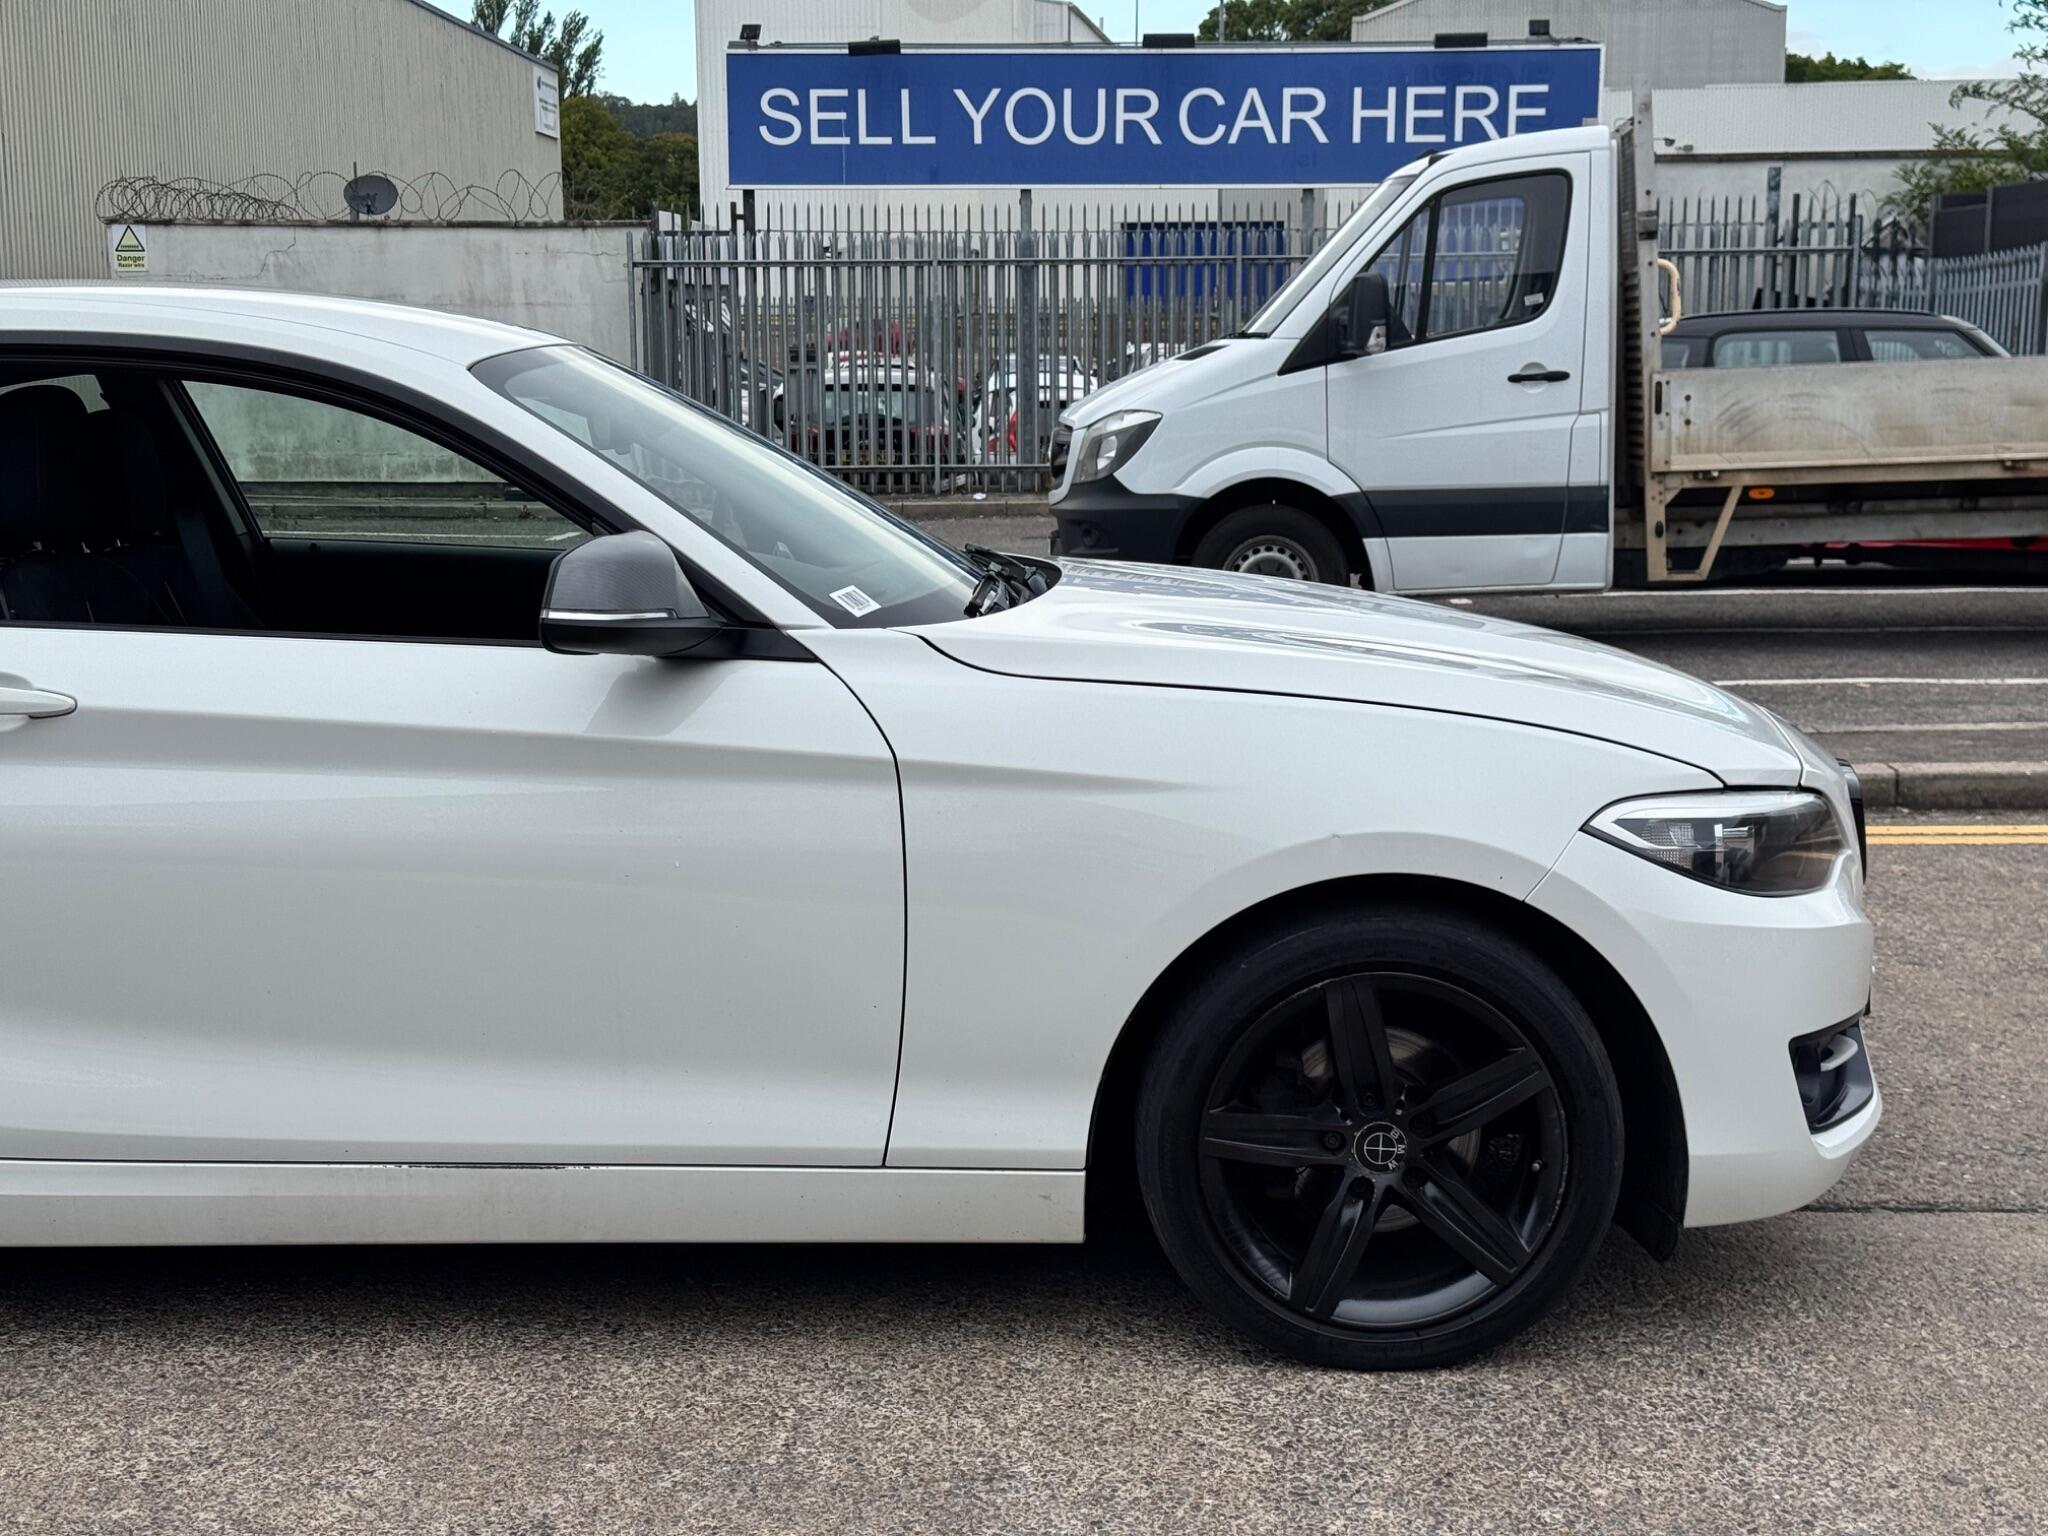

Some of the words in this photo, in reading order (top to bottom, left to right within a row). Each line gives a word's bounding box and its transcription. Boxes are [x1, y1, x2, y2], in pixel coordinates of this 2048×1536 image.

[759, 87, 936, 146] SELL
[953, 87, 1162, 146] YOUR
[1179, 86, 1329, 146] CAR
[1352, 84, 1550, 144] HERE
[117, 254, 145, 263] Danger
[1387, 1128, 1406, 1170] BMW
